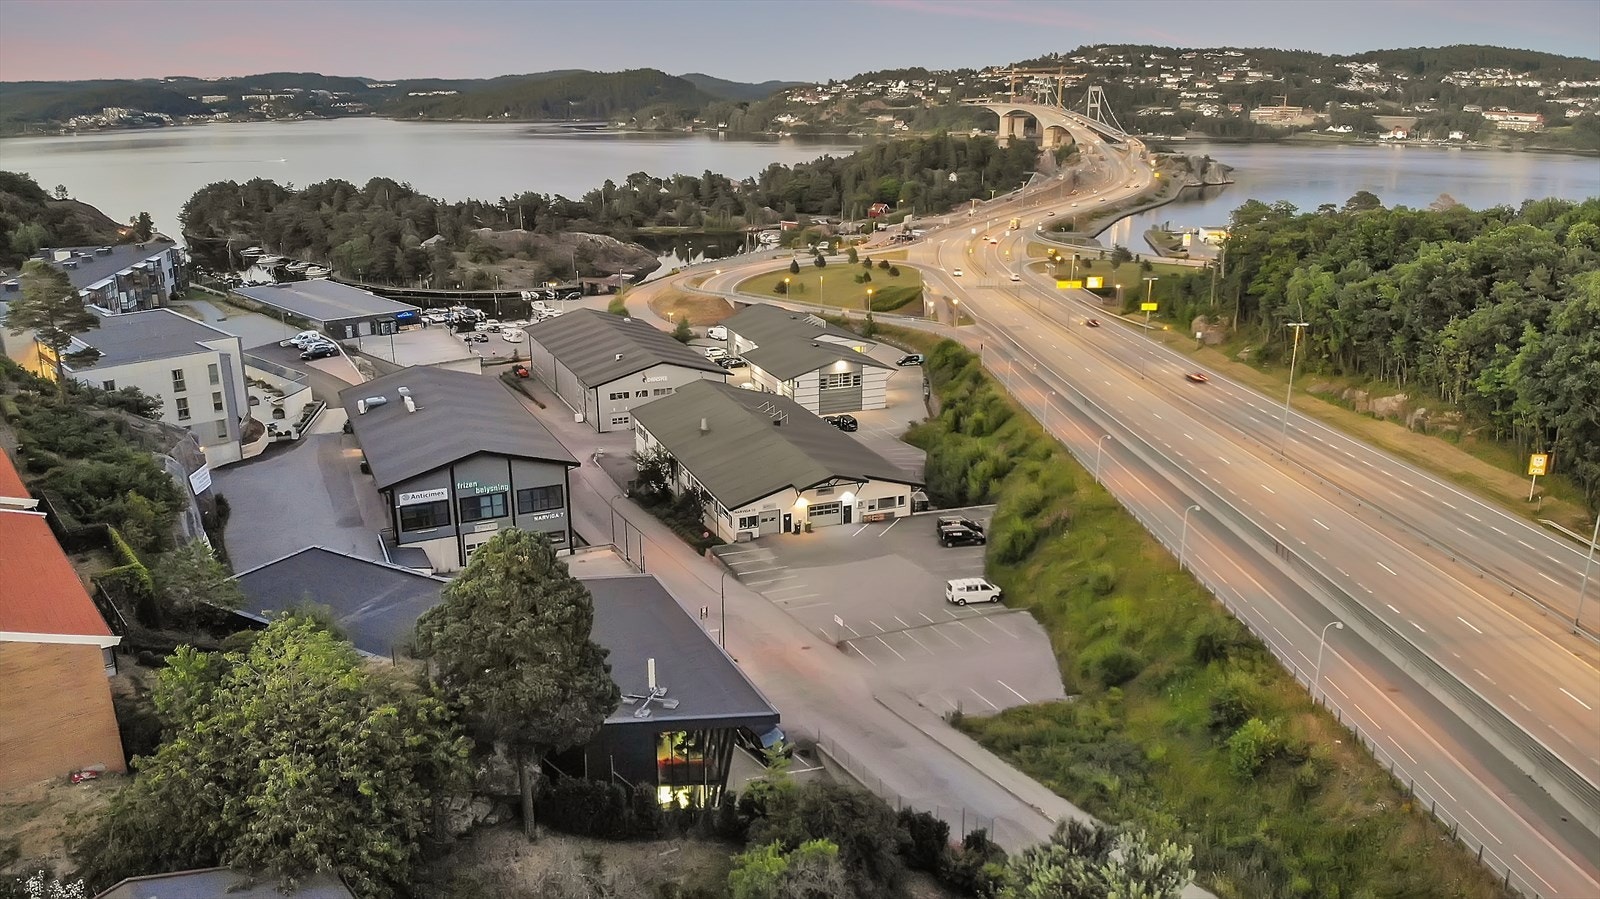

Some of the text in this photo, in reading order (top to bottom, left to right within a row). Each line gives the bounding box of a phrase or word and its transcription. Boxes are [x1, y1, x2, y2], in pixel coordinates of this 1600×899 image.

[457, 482, 478, 490] frizen
[475, 484, 509, 494] belysning
[410, 491, 444, 500] Anticimex
